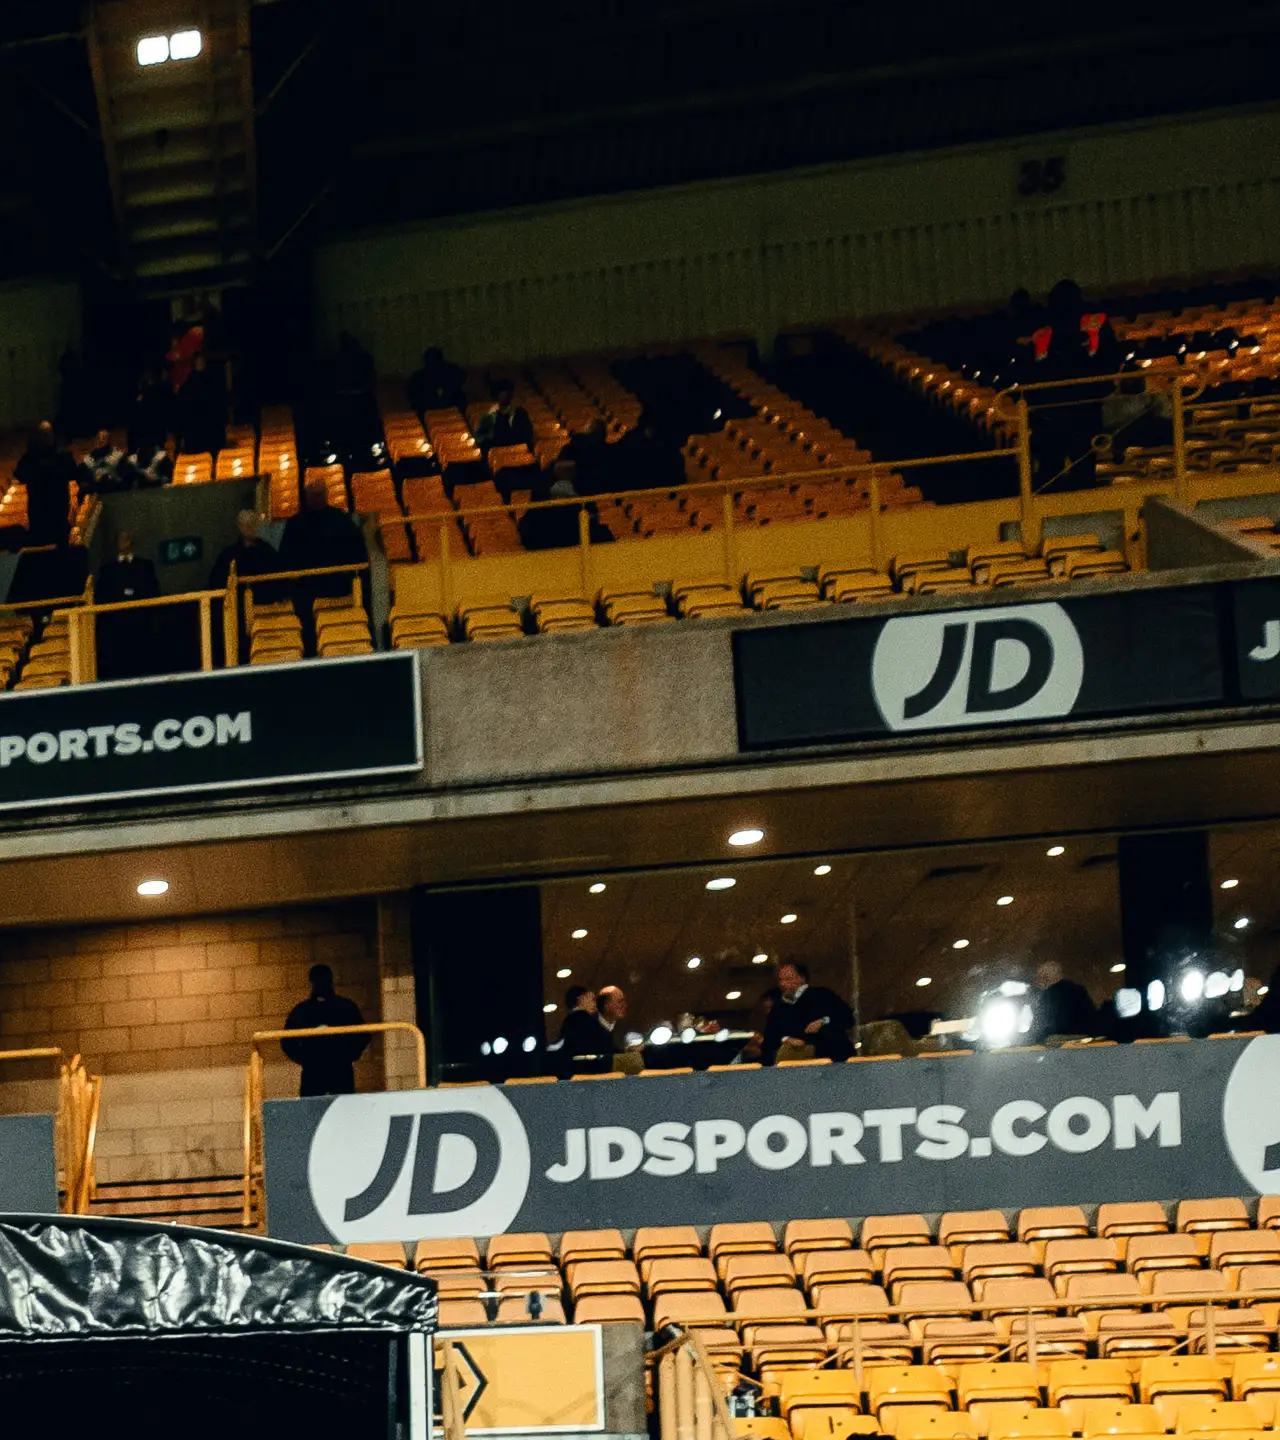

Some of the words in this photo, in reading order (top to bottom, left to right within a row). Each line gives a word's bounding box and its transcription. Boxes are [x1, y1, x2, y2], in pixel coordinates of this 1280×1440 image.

[903, 618, 1054, 720] JD
[343, 1110, 503, 1222] JD
[545, 1091, 1182, 1184] JDSPORTS.COM
